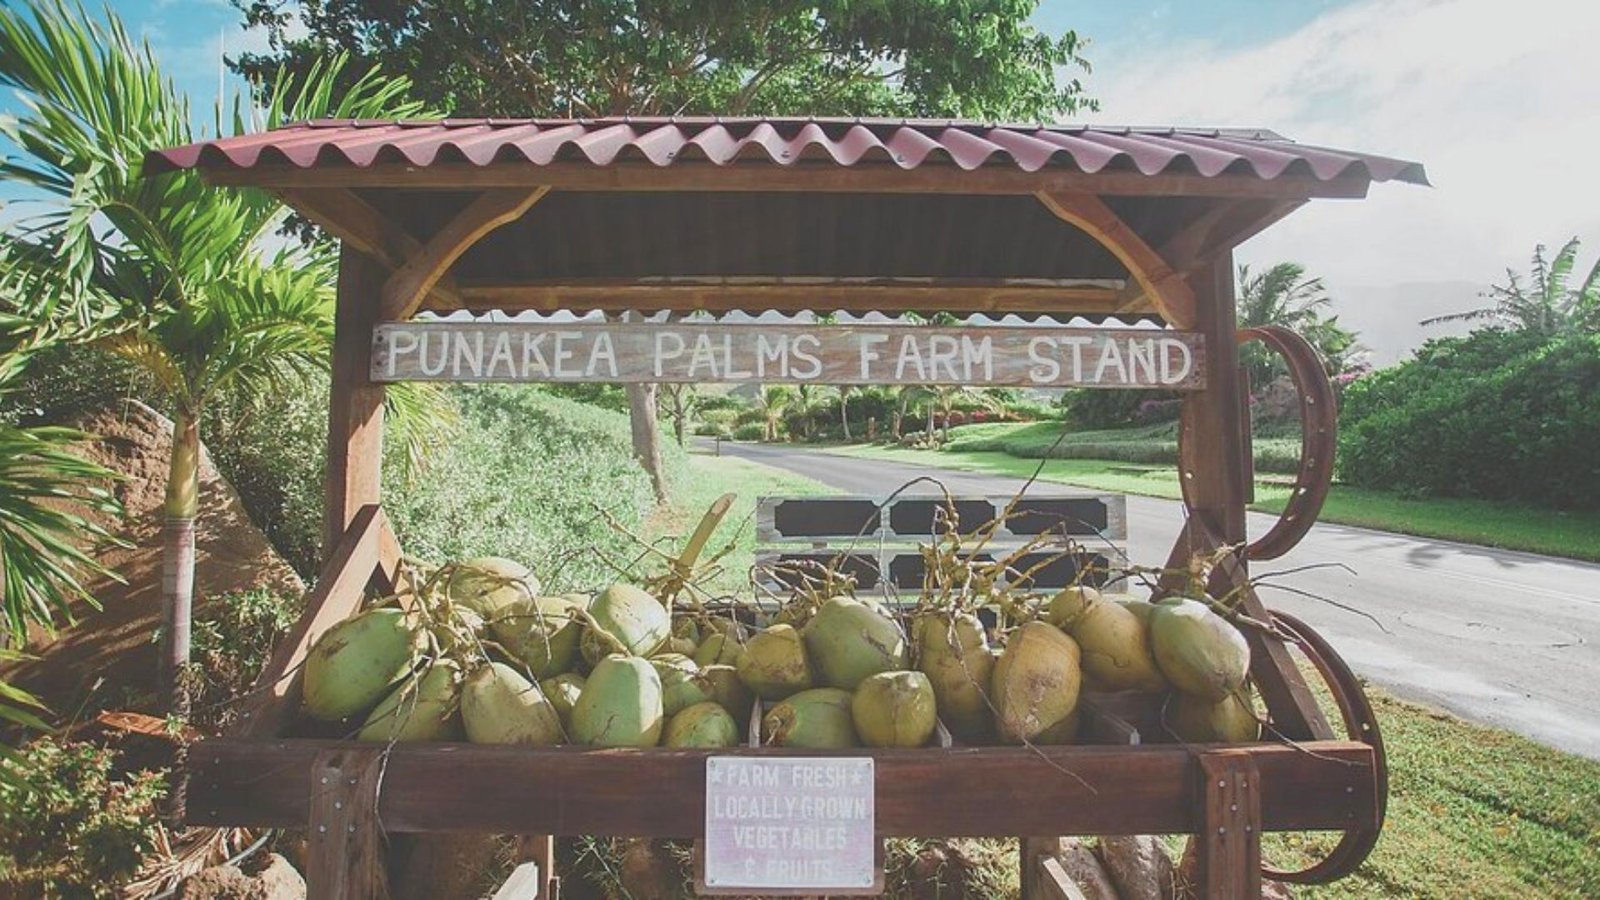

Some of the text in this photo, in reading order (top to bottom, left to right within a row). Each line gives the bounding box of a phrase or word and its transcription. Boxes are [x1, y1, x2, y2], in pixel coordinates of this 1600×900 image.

[387, 331, 1192, 385] PUNAKEA PALMS FARM STAND
[727, 765, 846, 788] FARM FRESH
[714, 796, 866, 819] LOCALLY GROWN
[734, 826, 847, 849] VEGETABLES
[767, 860, 832, 880] FRUITS
